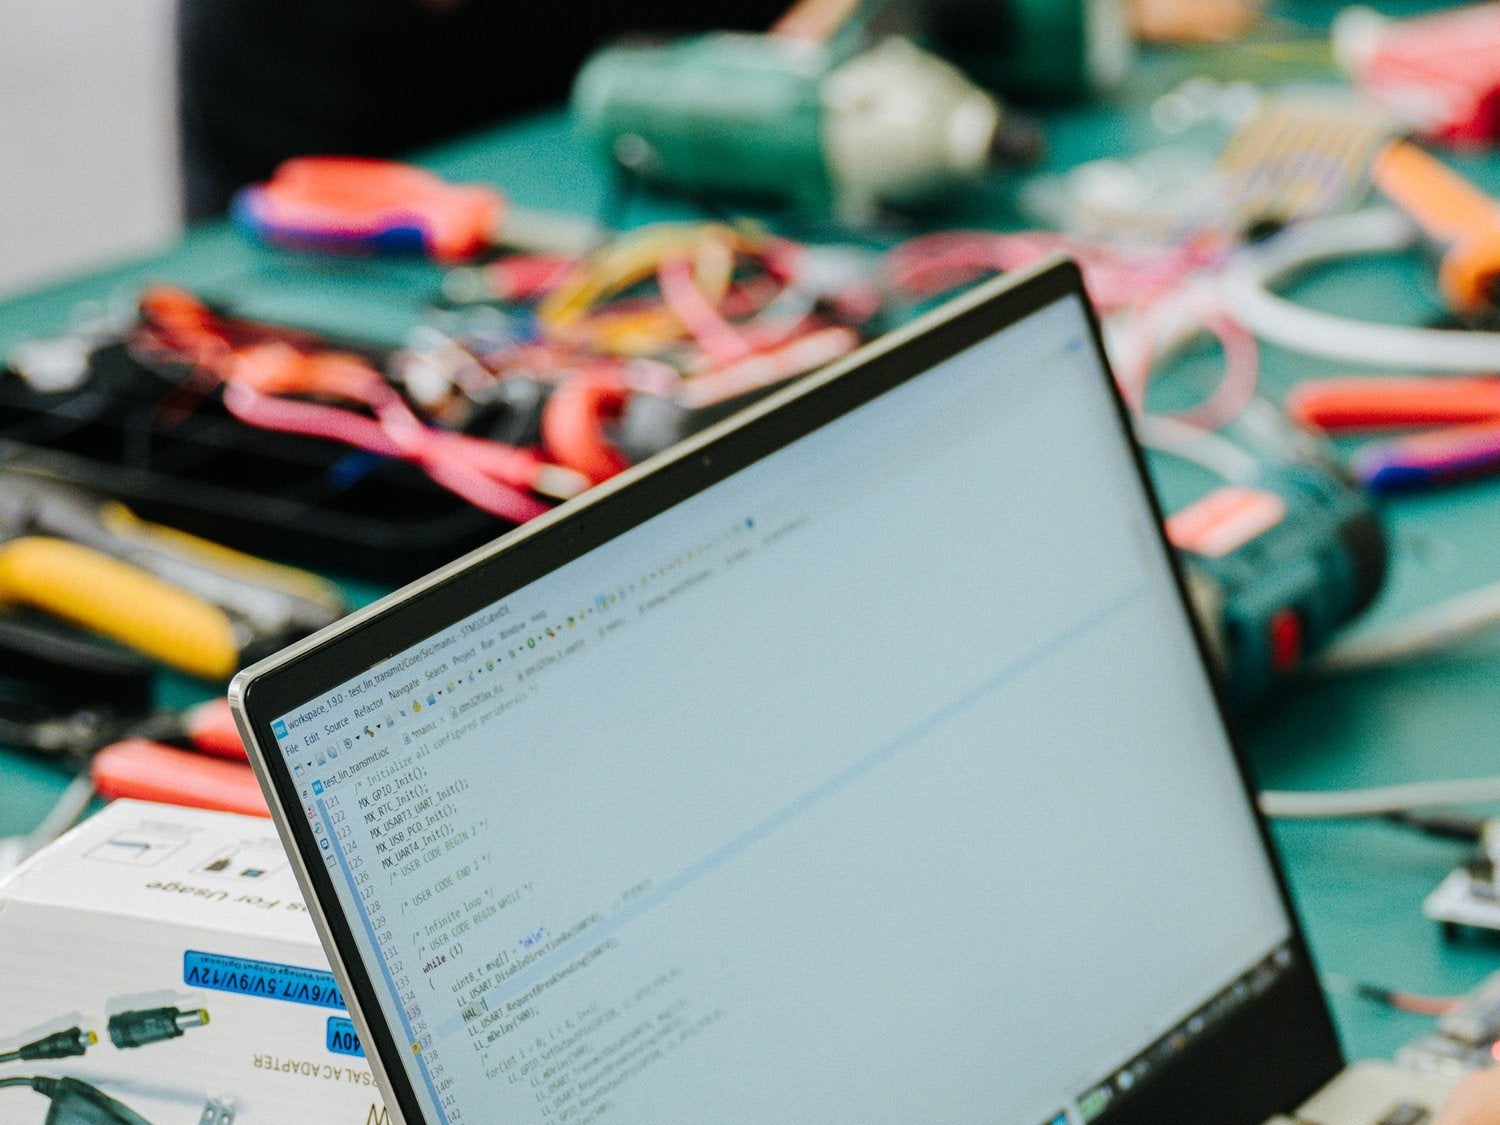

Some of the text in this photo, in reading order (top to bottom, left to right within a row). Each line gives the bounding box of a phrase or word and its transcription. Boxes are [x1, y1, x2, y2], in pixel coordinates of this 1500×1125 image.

[283, 740, 300, 757] File
[302, 729, 320, 747] Edit
[323, 713, 350, 736] Source
[352, 695, 385, 720] Refactor
[387, 675, 421, 703] Navigate
[423, 660, 449, 682] Search
[451, 645, 478, 669] Project
[286, 691, 345, 733] workspace_1.9.0
[321, 744, 391, 791] test_lin_transmit.ioc
[324, 794, 341, 811] 121
[335, 781, 430, 841] 123 MX_RTC_Init();
[329, 809, 347, 826] 122
[341, 776, 470, 856] 124 MX_USART3_UART_Init();
[347, 801, 458, 872] 125 MX_USB_PCD_Init();
[353, 820, 455, 887] 126 MX_UART4_Init();
[359, 884, 376, 902] 127
[399, 858, 422, 878] USER
[421, 845, 443, 865] CODE
[144, 880, 217, 901] Usage
[365, 900, 382, 917] 128
[371, 915, 388, 932] 129
[411, 887, 433, 908] USER
[433, 875, 455, 895] CODE
[377, 930, 393, 947] 130
[383, 945, 399, 962] 131
[388, 960, 405, 977] 132
[428, 932, 451, 953] USER
[450, 919, 471, 939] CODE
[394, 942, 465, 992] 133 while (1)
[400, 989, 417, 1007] 134
[406, 1004, 422, 1022] 135
[412, 1019, 428, 1037] 136
[417, 1034, 434, 1051] 137
[253, 1053, 344, 1080] AC ADAPTER
[423, 1049, 440, 1066] 138
[429, 1063, 445, 1081] 139
[435, 1078, 451, 1096] 140
[440, 1093, 457, 1111] 141
[446, 1107, 463, 1125] 142
